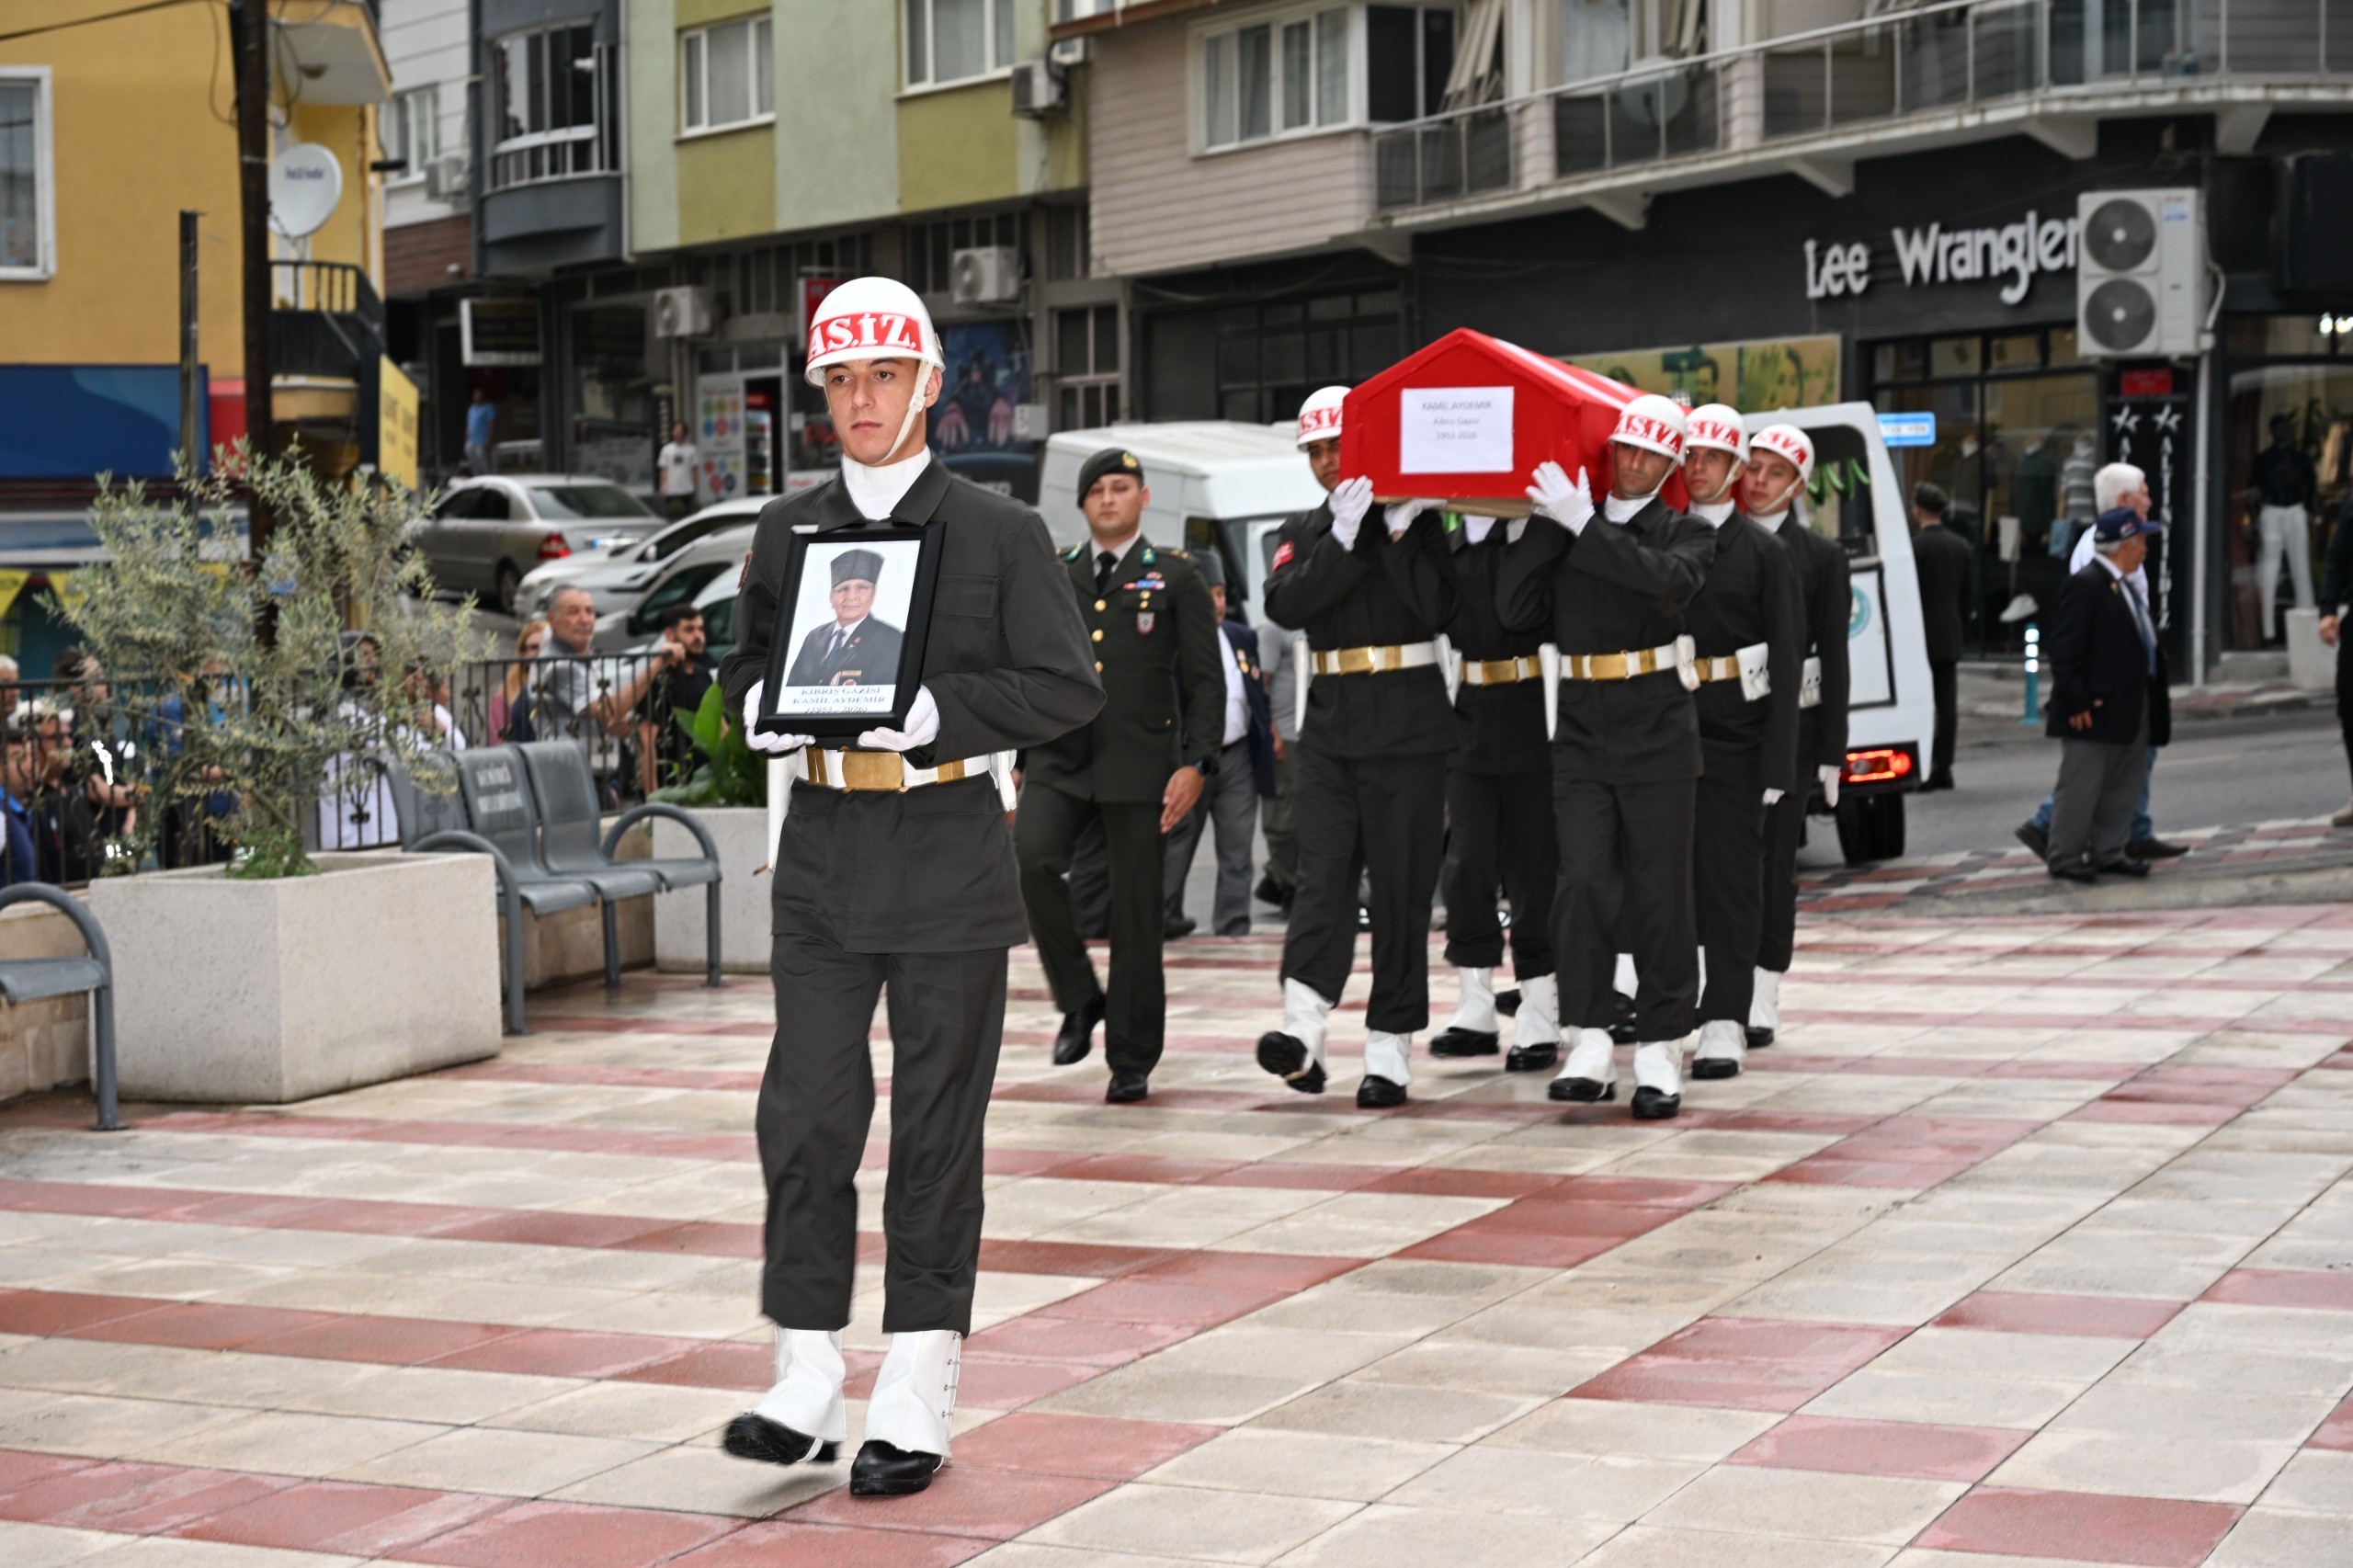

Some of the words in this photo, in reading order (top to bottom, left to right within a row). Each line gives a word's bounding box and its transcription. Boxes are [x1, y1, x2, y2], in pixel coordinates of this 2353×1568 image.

[1804, 238, 1870, 298] Lee
[1893, 210, 2079, 304] Wrangler
[793, 696, 831, 704] KAMİL
